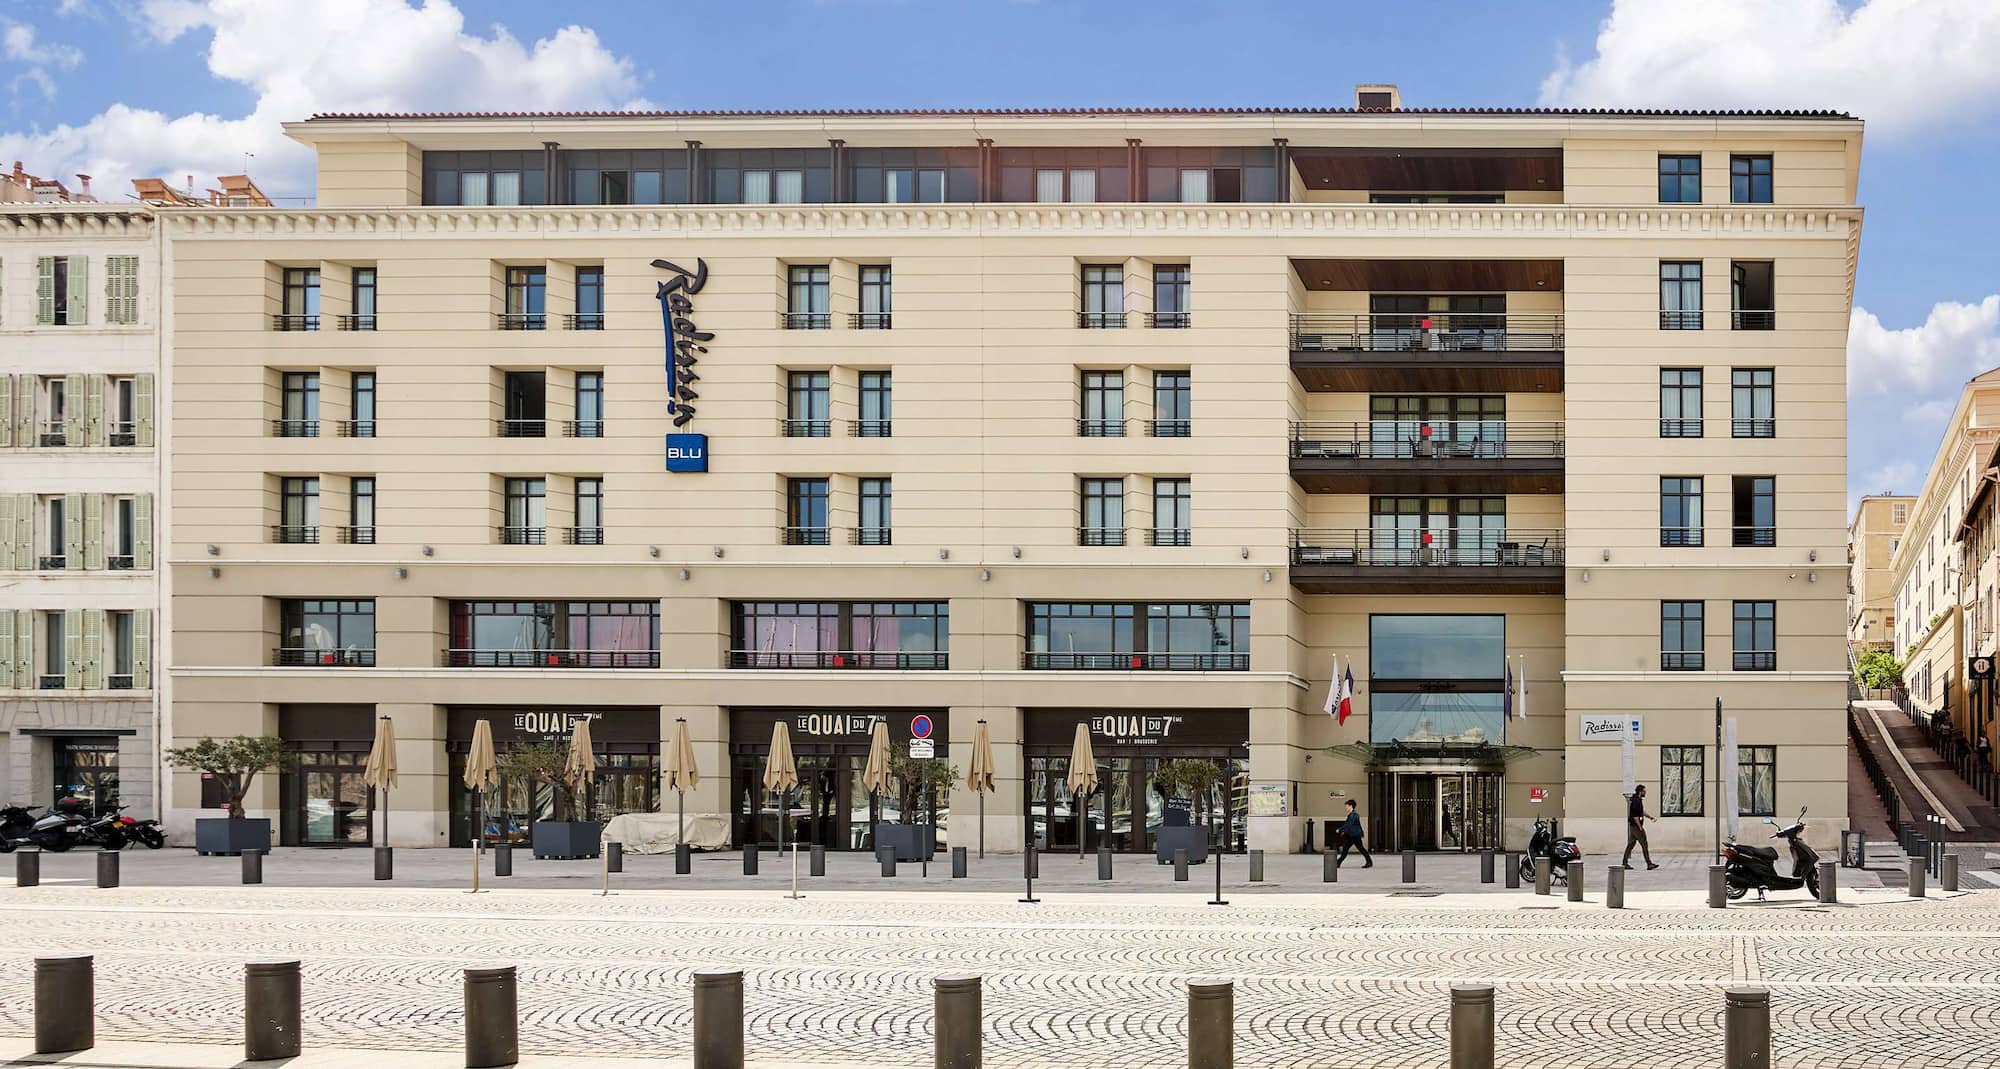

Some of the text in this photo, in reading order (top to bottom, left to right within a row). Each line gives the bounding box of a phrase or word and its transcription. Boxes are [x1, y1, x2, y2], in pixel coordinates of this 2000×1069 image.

[650, 256, 715, 427] Radisson
[667, 447, 702, 459] BLU
[514, 716, 524, 726] LE
[525, 712, 567, 733] QUAI
[797, 719, 807, 729] LE
[808, 714, 850, 735] QUAI
[853, 719, 865, 729] DU
[1092, 720, 1102, 730] LE
[1103, 715, 1146, 737] QUAI
[1148, 720, 1161, 730] DU
